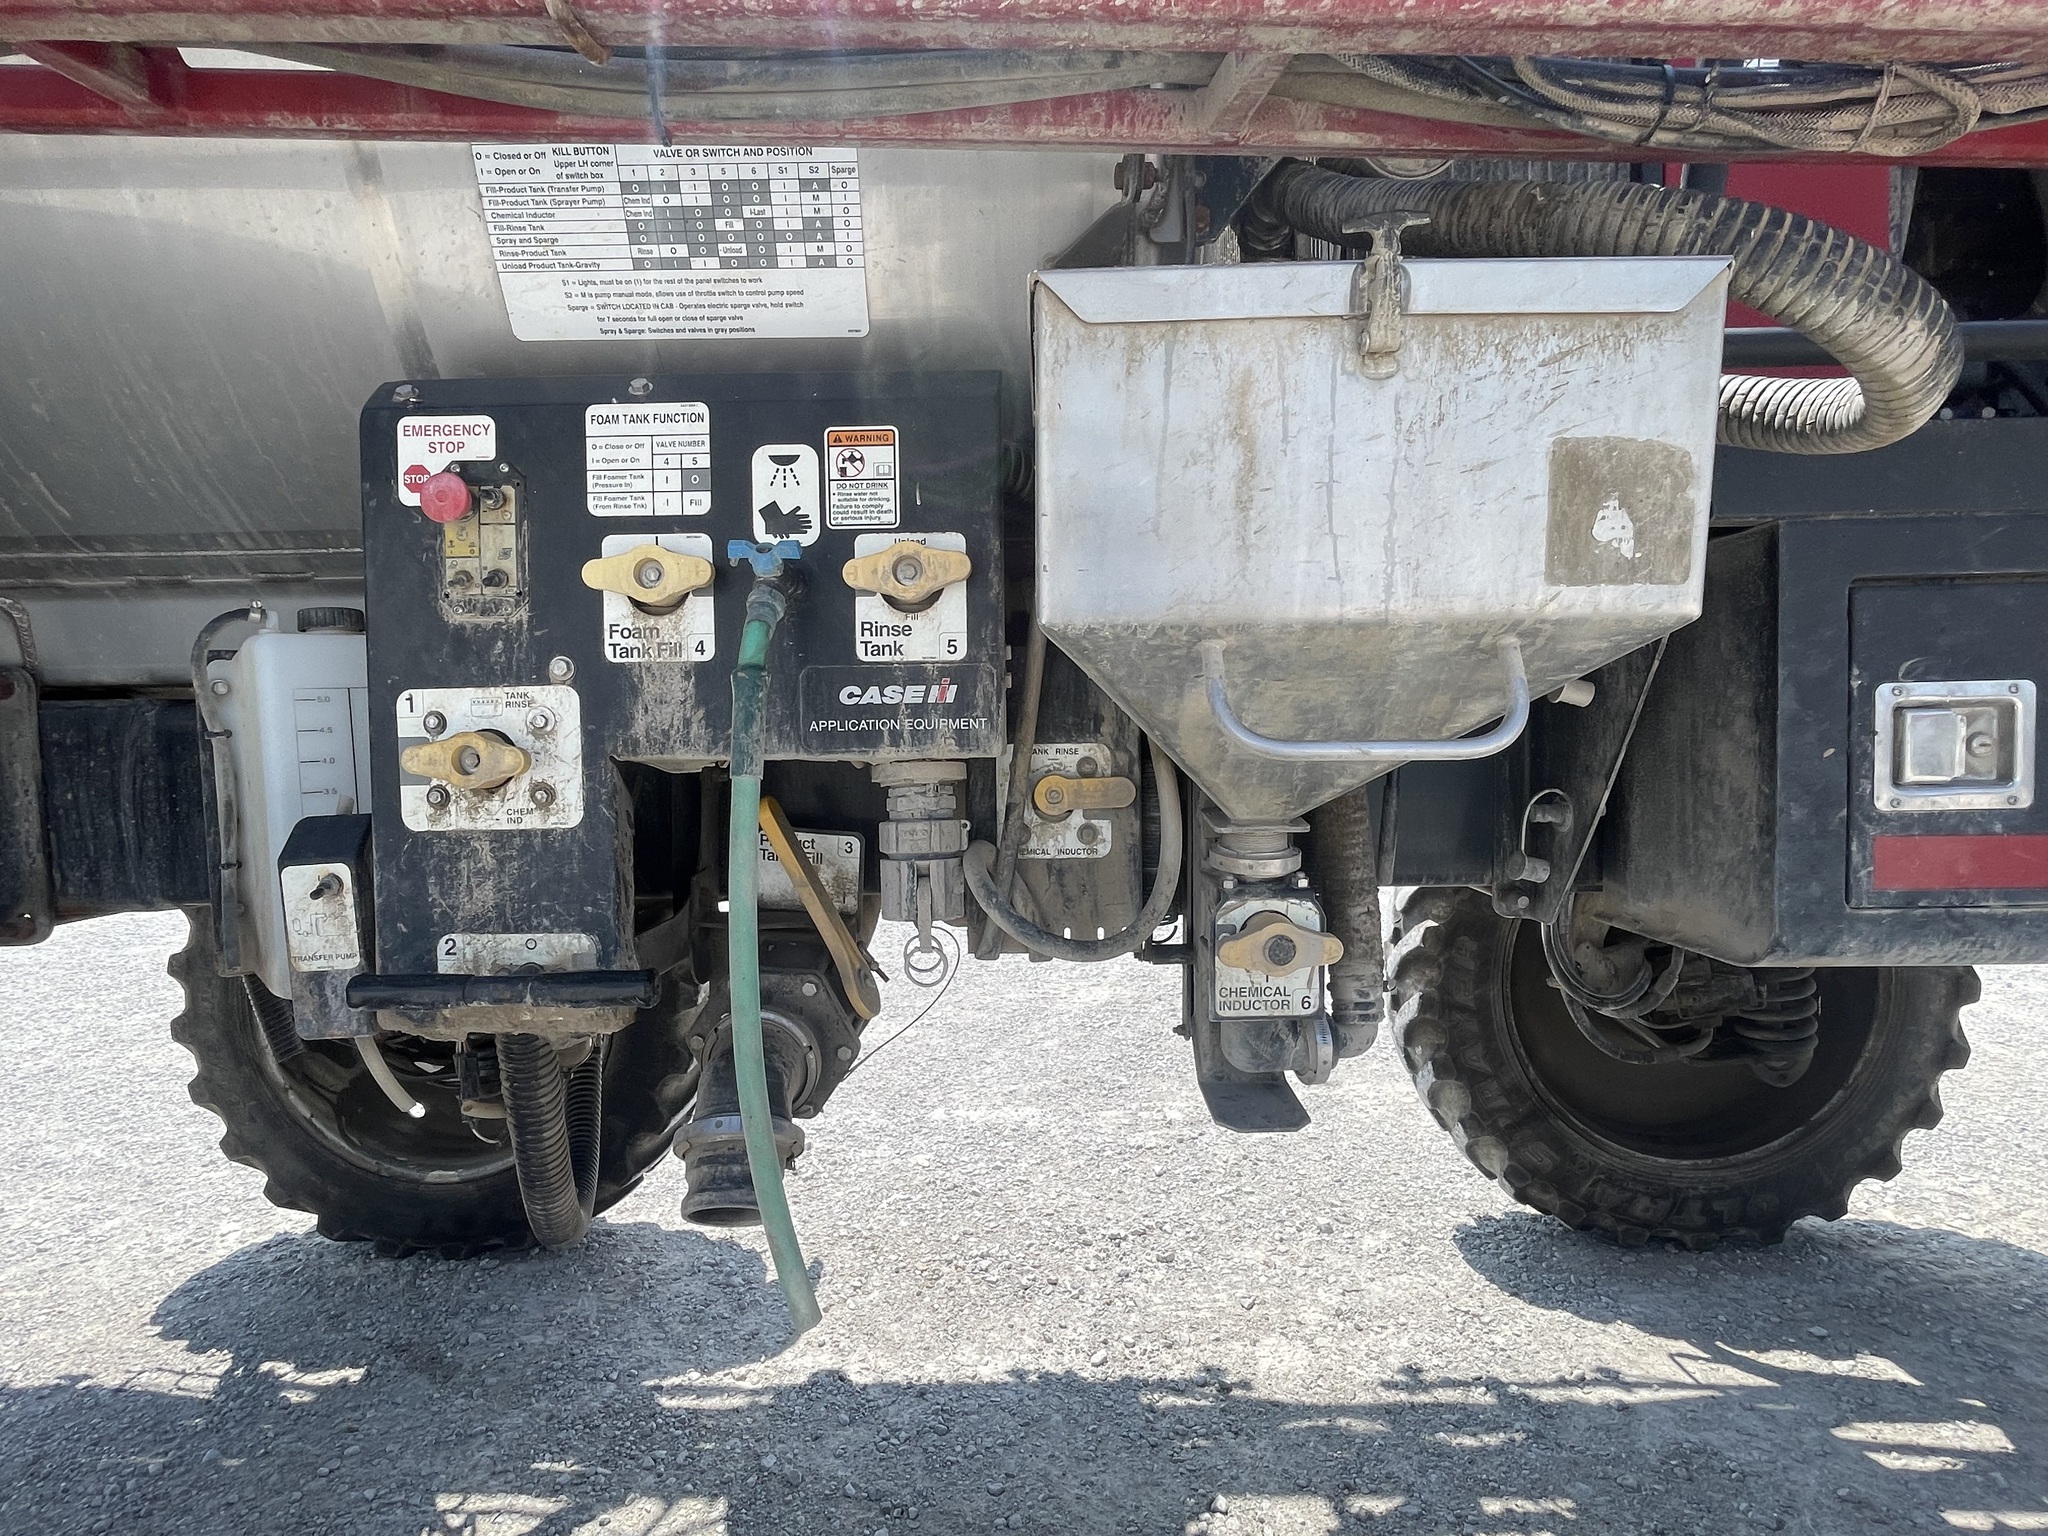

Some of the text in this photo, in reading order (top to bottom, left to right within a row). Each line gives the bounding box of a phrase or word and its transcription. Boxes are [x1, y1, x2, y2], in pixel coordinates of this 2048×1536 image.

[493, 152, 521, 160] Closed
[552, 147, 609, 156] KILL BUTTON
[653, 147, 813, 158] VALVE OR SWITCH AND POSITION
[554, 160, 576, 169] Upper
[495, 168, 516, 177] Open
[529, 167, 540, 175] On
[591, 171, 603, 179] box
[691, 168, 696, 176] 3
[832, 166, 856, 175] Sparge
[548, 185, 578, 193] (Transfer
[581, 185, 604, 193] Pump)
[550, 198, 580, 207] (Sprayer
[582, 198, 605, 206] Pump)
[494, 224, 526, 232] Fill-Rinse
[496, 236, 559, 245] Spray and Sparge
[557, 262, 600, 270] Tank-Gravity
[591, 412, 704, 424] FOAM TANK FUNCTION
[403, 424, 490, 437] EMERGENCY
[846, 434, 889, 442] WARNING
[428, 441, 465, 453] STOP
[693, 457, 697, 465] 5
[609, 624, 659, 639] Foam
[860, 621, 912, 637] Rinse
[608, 642, 682, 658] Tank Fill
[695, 640, 705, 655] 4
[860, 641, 904, 656] Tank
[947, 639, 957, 654] 5
[505, 692, 530, 700] TANK
[839, 685, 926, 705] CASE
[405, 693, 414, 713] 1
[505, 700, 532, 708] RINSE
[810, 718, 987, 732] APPLICATION EQUIPMENT
[507, 808, 534, 816] CHEM
[844, 842, 853, 854] 3
[444, 938, 457, 956] 2
[292, 954, 334, 962] TRANSFER
[1219, 986, 1291, 998] CHEMICAL
[1219, 1000, 1290, 1011] INDUCTOR
[1301, 996, 1311, 1009] 6
